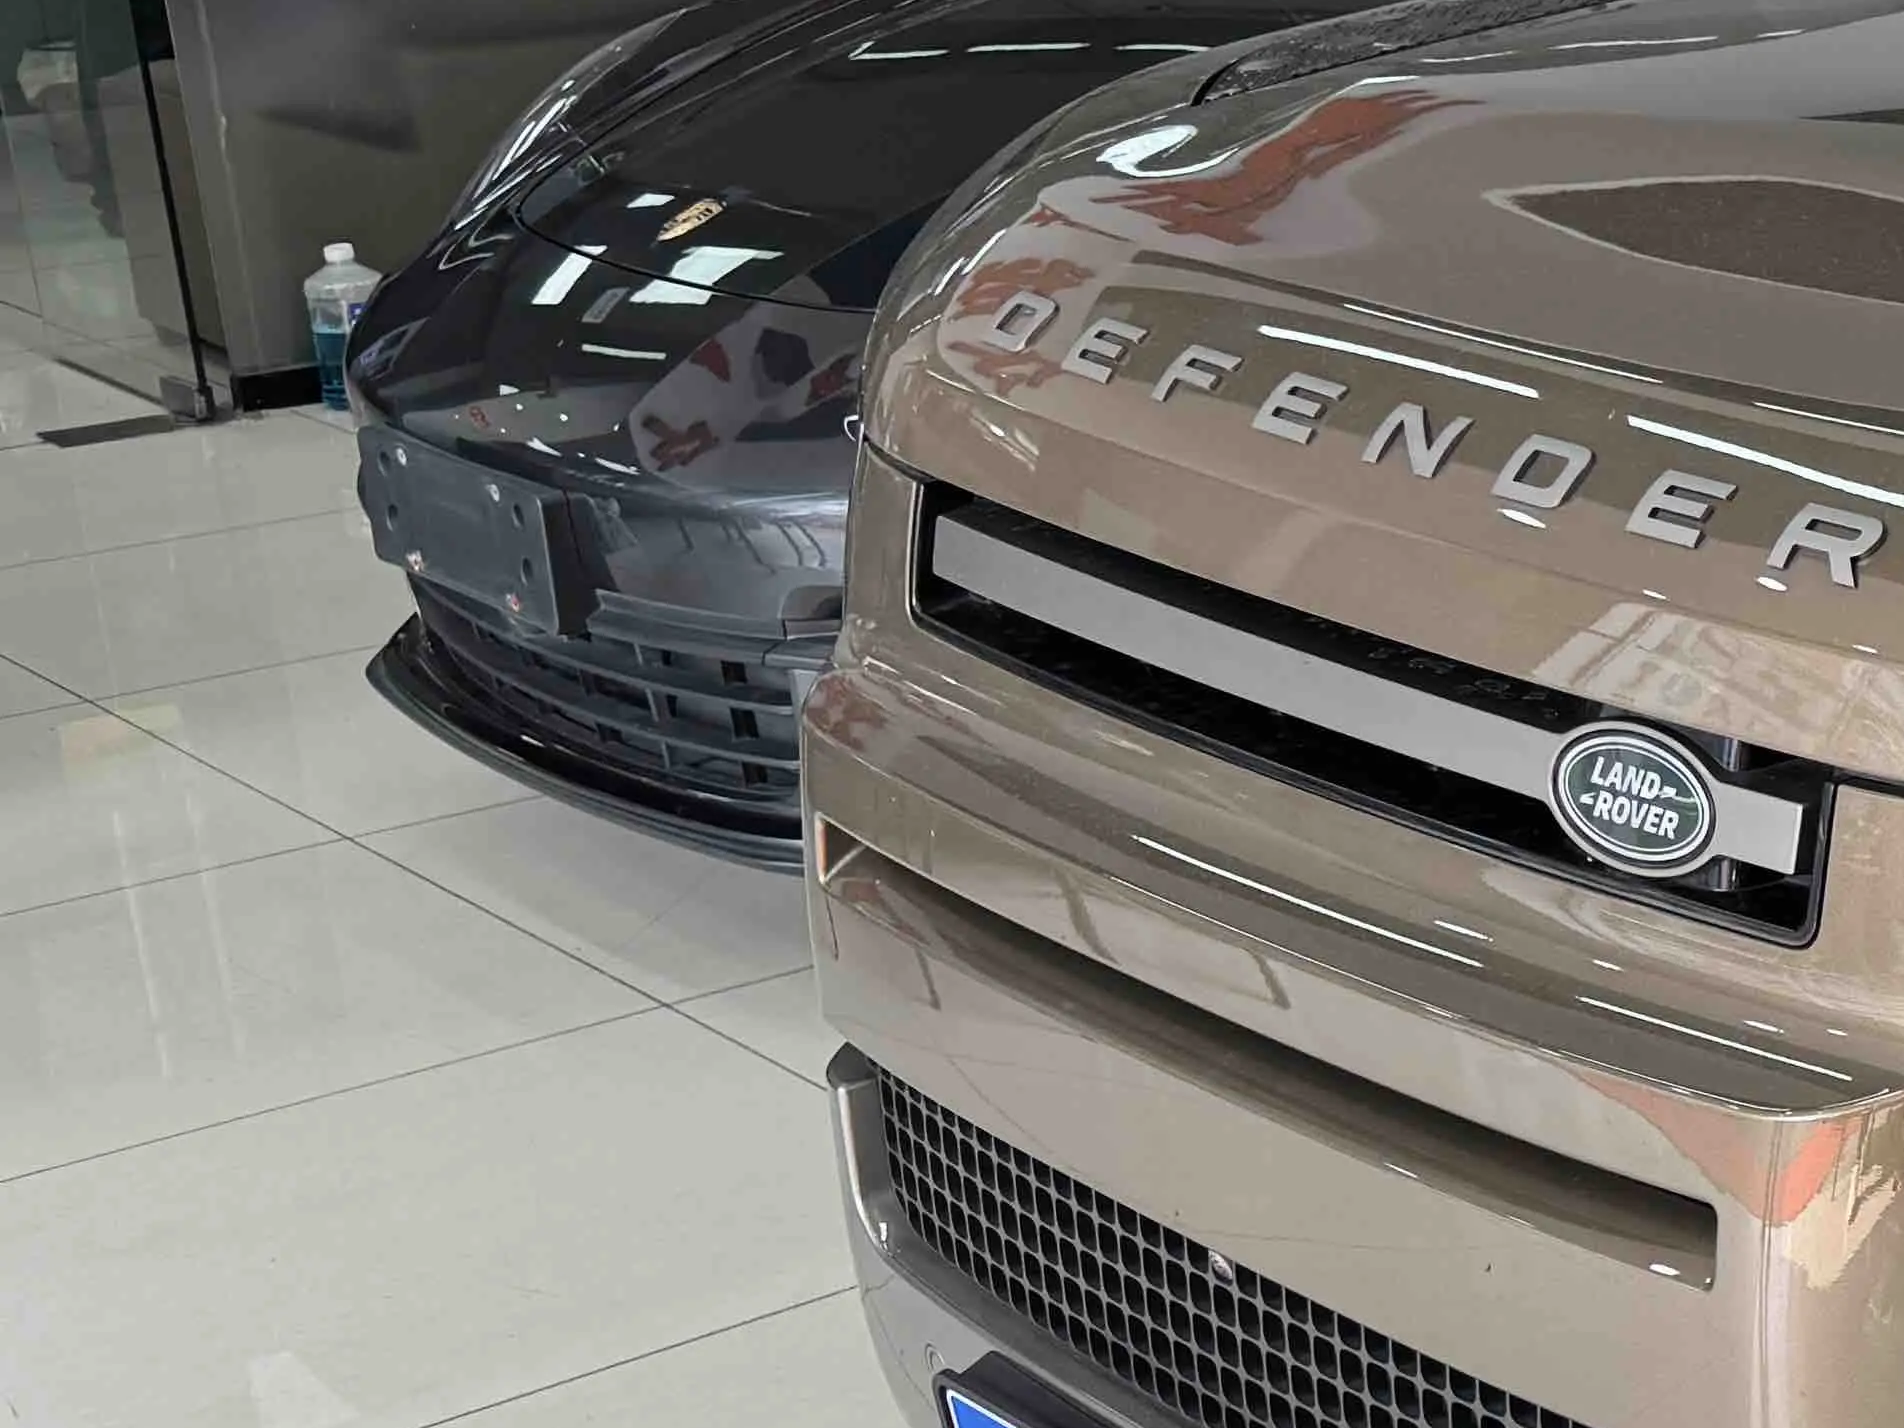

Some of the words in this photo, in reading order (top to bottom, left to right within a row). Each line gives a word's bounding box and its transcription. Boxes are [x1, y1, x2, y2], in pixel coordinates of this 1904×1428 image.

[986, 290, 1886, 589] DEFENDER
[1590, 755, 1662, 800] LAND
[1592, 790, 1680, 840] ROVER
